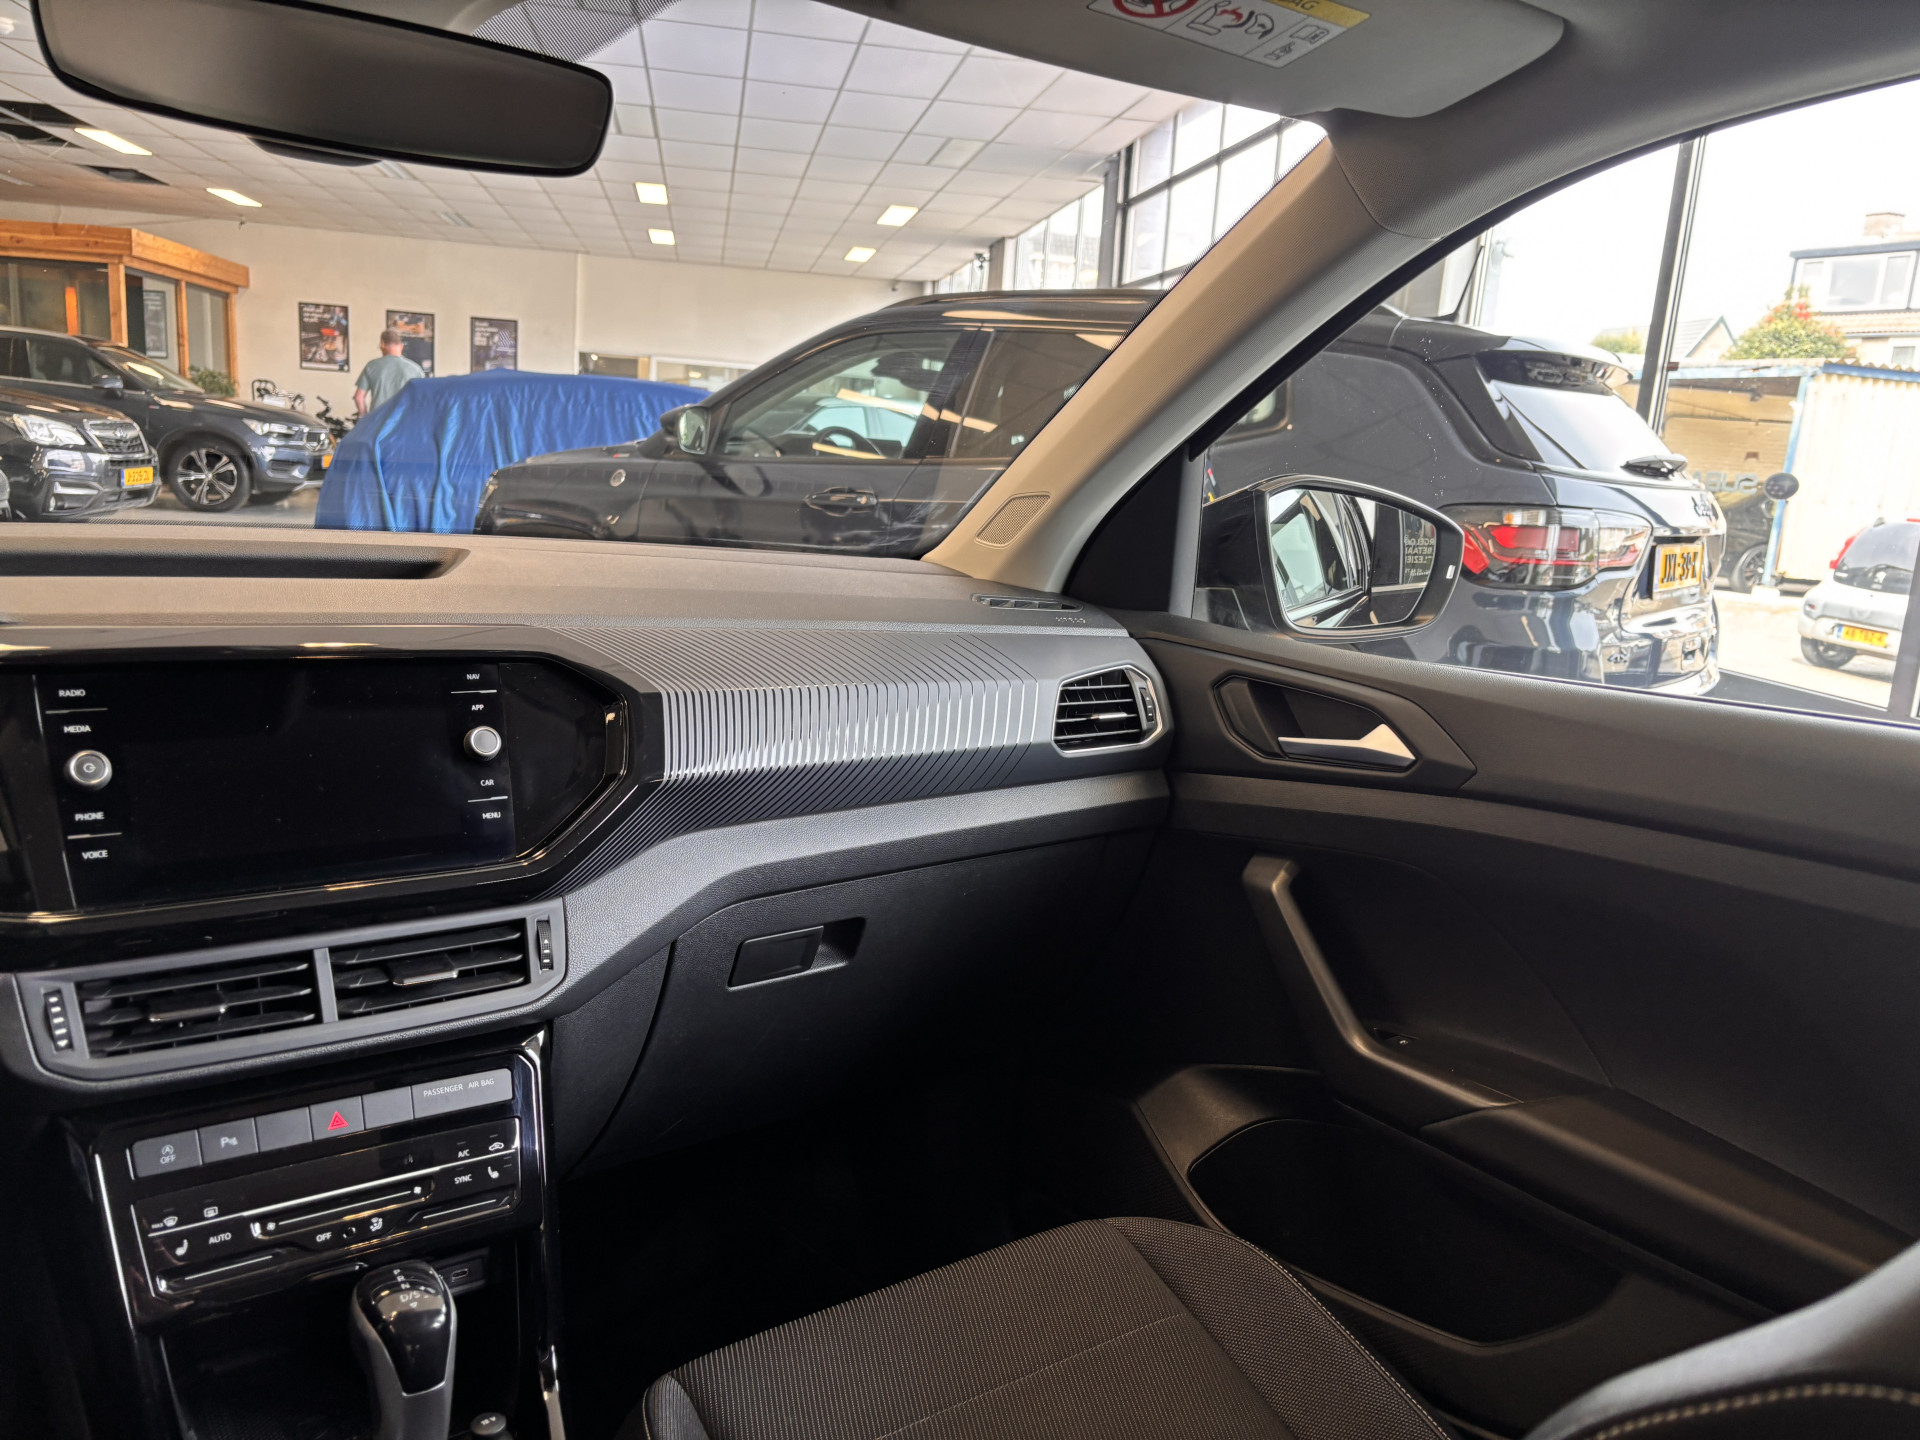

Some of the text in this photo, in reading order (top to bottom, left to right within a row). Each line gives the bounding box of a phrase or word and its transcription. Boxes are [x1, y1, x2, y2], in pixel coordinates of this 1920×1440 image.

[58, 689, 86, 697] RADIO
[63, 725, 91, 733] MEDIA
[74, 812, 104, 821] PHONE
[82, 850, 108, 859] VOICE
[423, 1078, 495, 1097] PASSENGER AIR BAG
[457, 1149, 471, 1158] A/C
[160, 1154, 176, 1164] OFF
[454, 1174, 472, 1184] SYNC
[208, 1232, 232, 1244] AUTO
[316, 1232, 332, 1242] OFF
